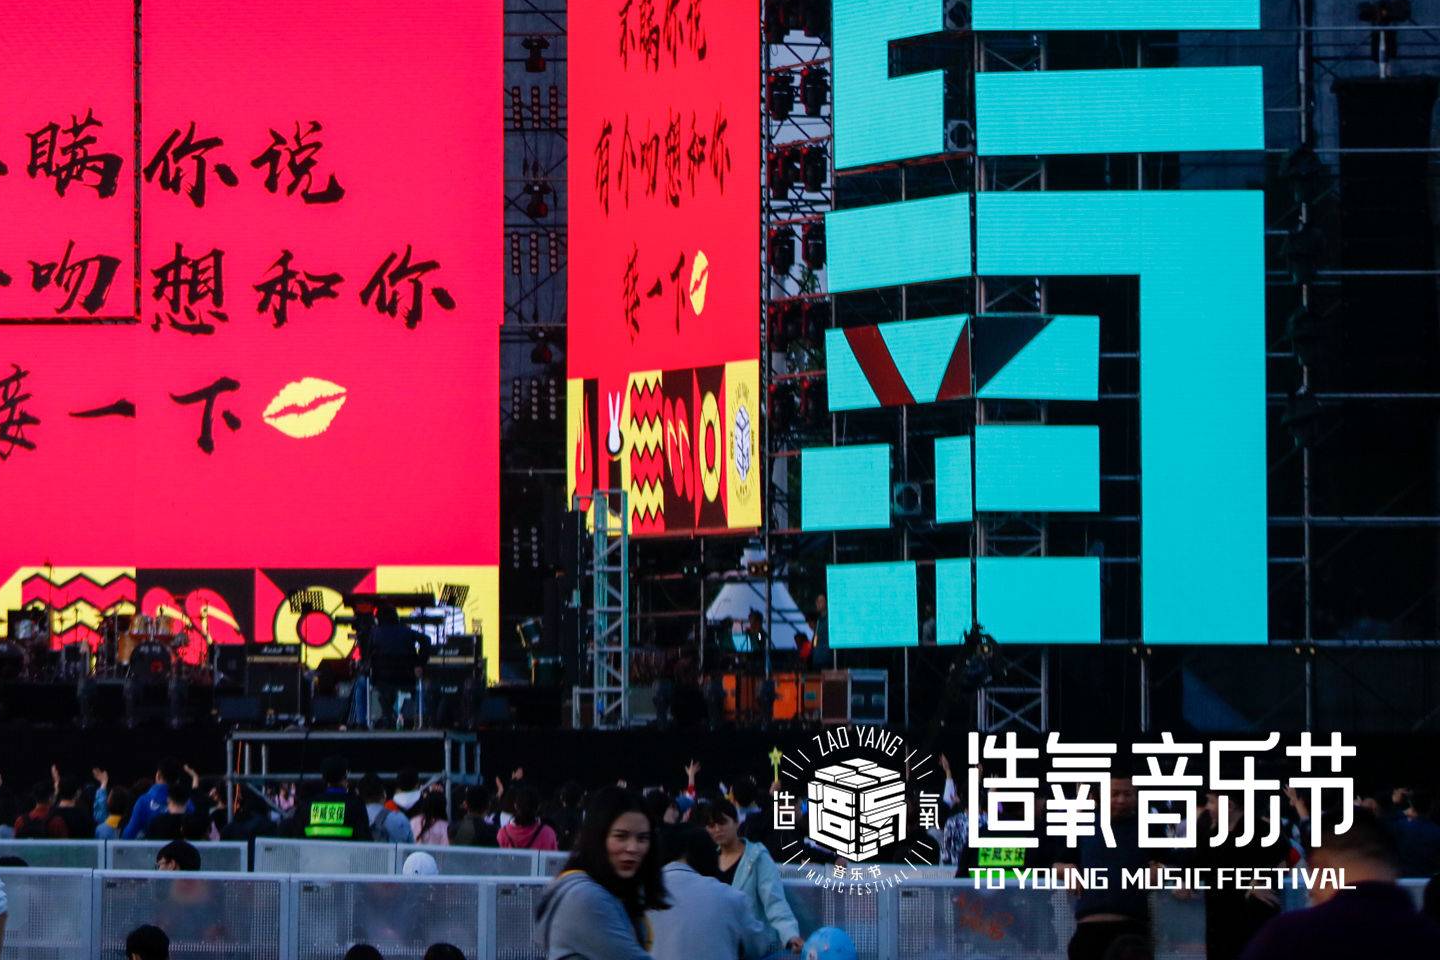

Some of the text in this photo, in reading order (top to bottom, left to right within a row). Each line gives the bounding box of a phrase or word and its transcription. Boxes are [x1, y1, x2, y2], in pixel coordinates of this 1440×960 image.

[594, 102, 731, 217] 有个吻想和你
